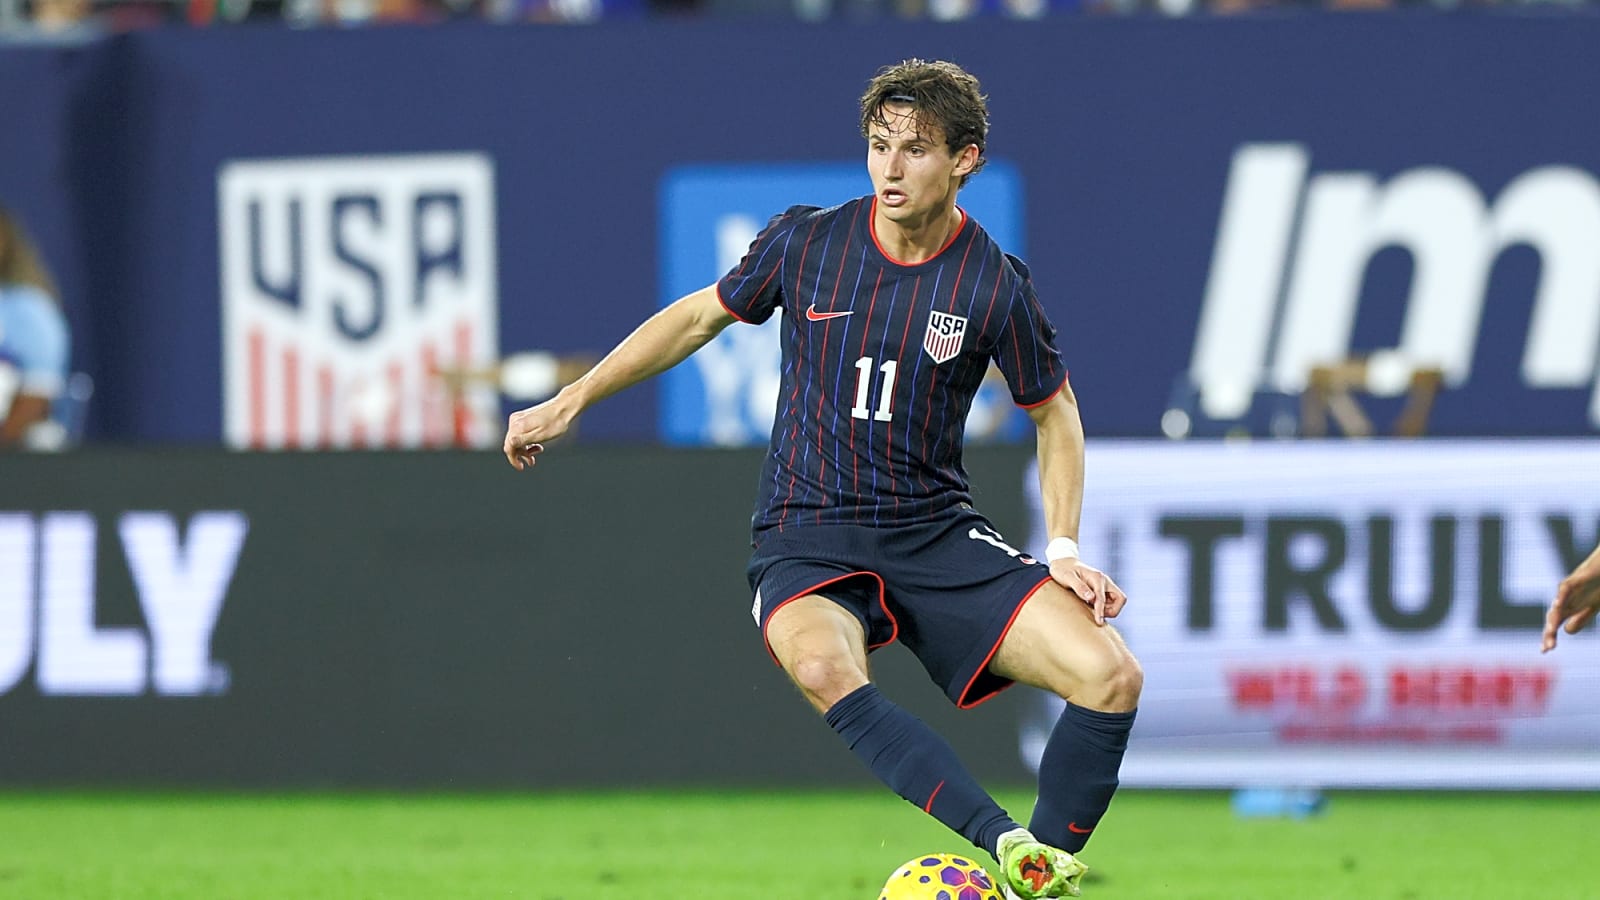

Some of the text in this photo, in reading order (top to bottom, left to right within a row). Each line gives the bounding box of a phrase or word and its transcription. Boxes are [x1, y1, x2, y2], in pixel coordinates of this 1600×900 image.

[248, 192, 466, 342] USA
[1190, 143, 1600, 415] Im
[931, 313, 965, 335] USA
[851, 356, 897, 421] 11
